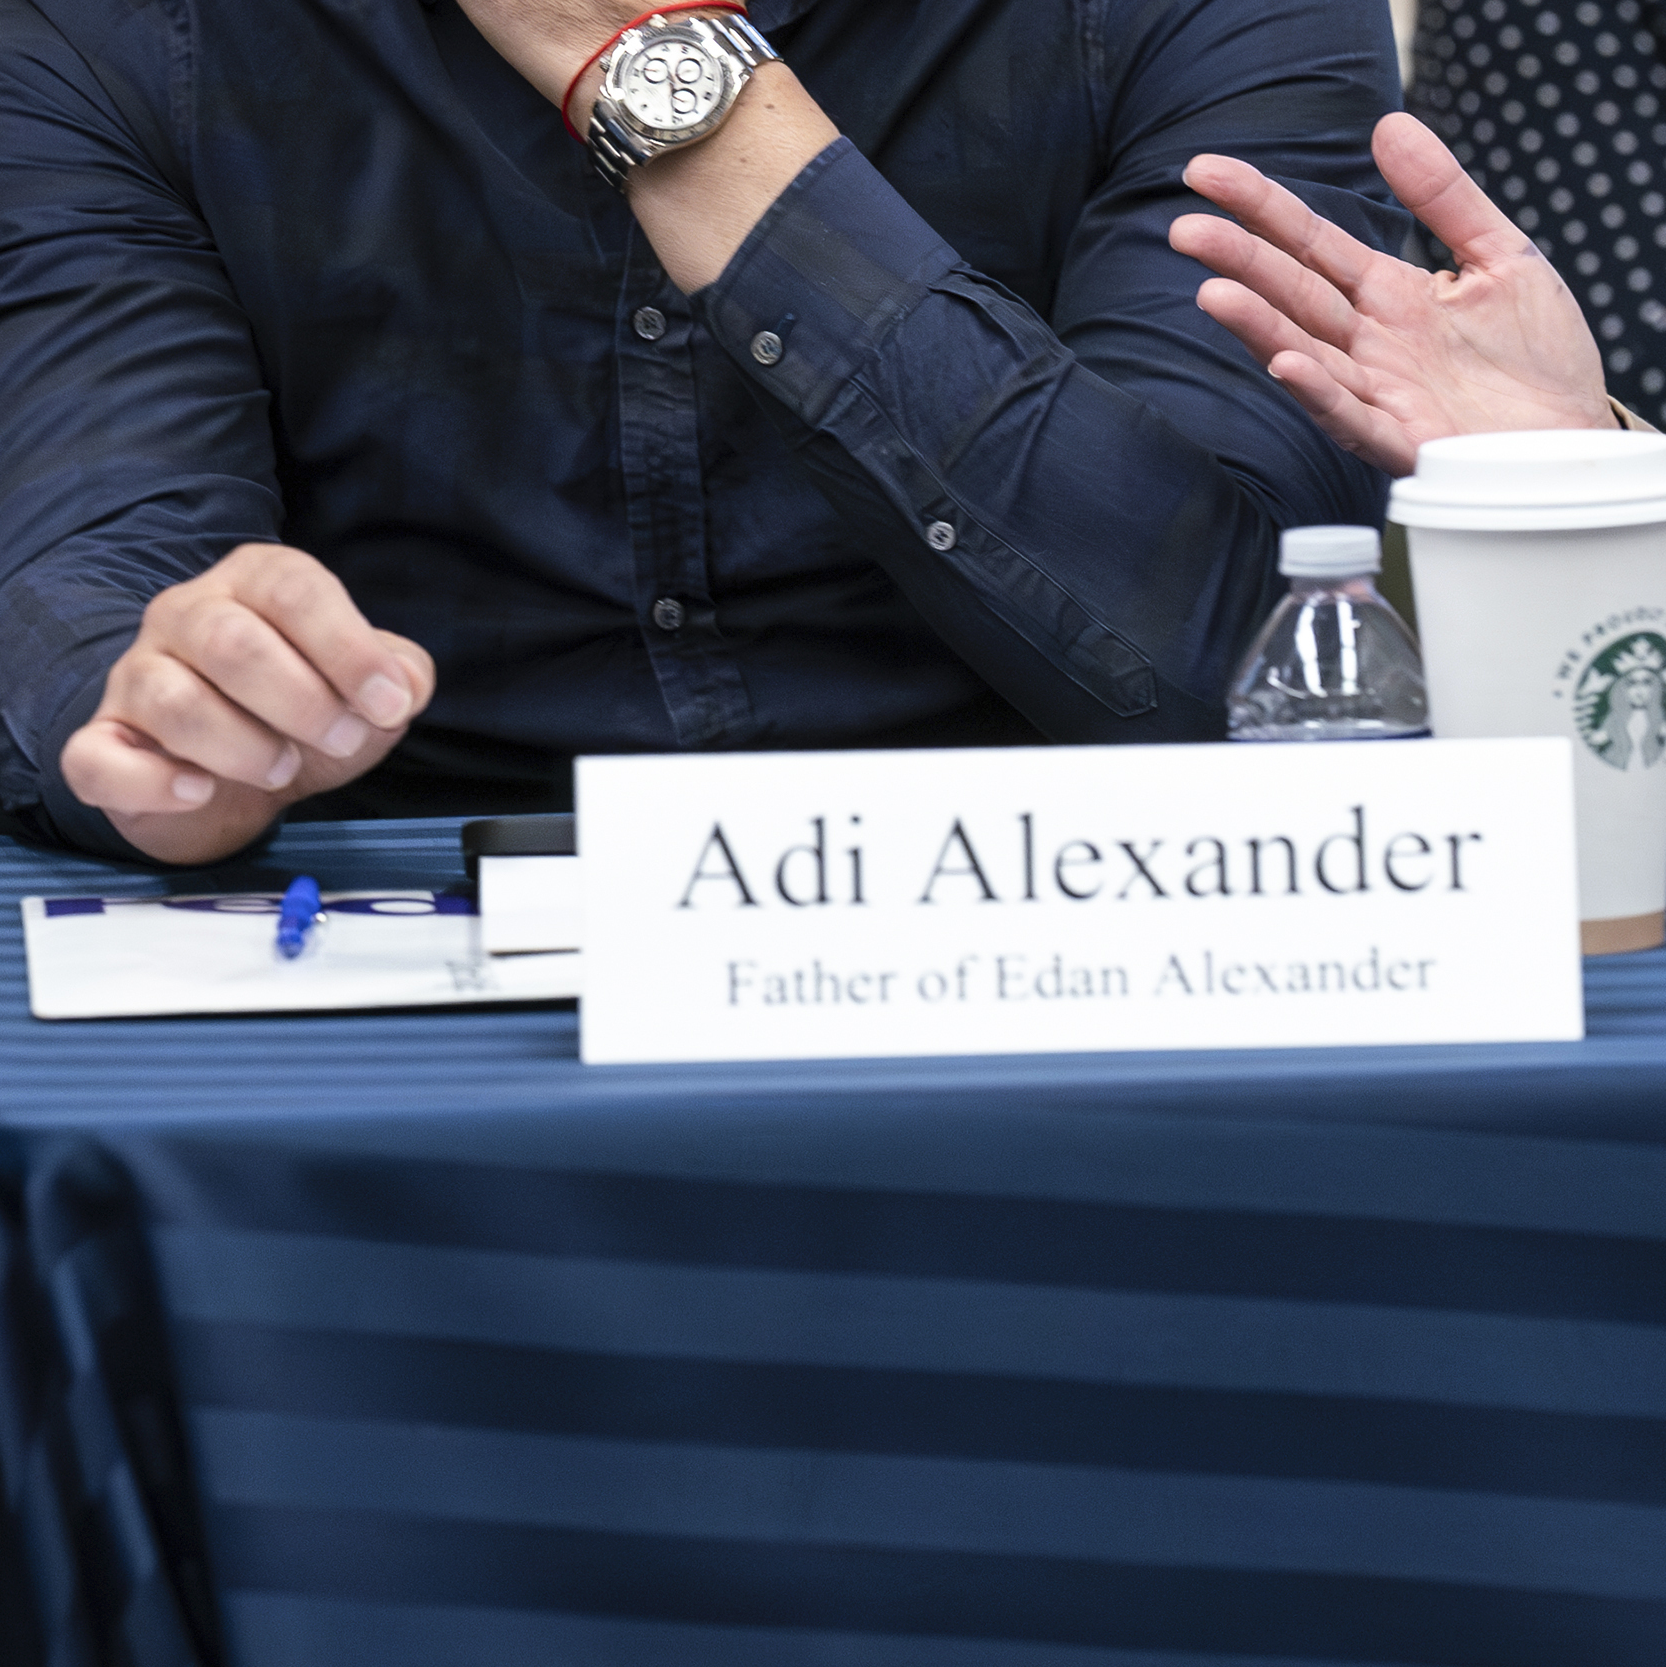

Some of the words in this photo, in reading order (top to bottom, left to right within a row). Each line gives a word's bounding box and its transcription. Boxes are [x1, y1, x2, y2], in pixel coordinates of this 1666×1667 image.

[675, 814, 868, 910] Adi
[917, 803, 1484, 906] Alexander
[727, 960, 896, 1006] Father
[917, 954, 979, 1001] of
[995, 954, 1129, 1001] Edan
[1154, 946, 1435, 996] Alexander
